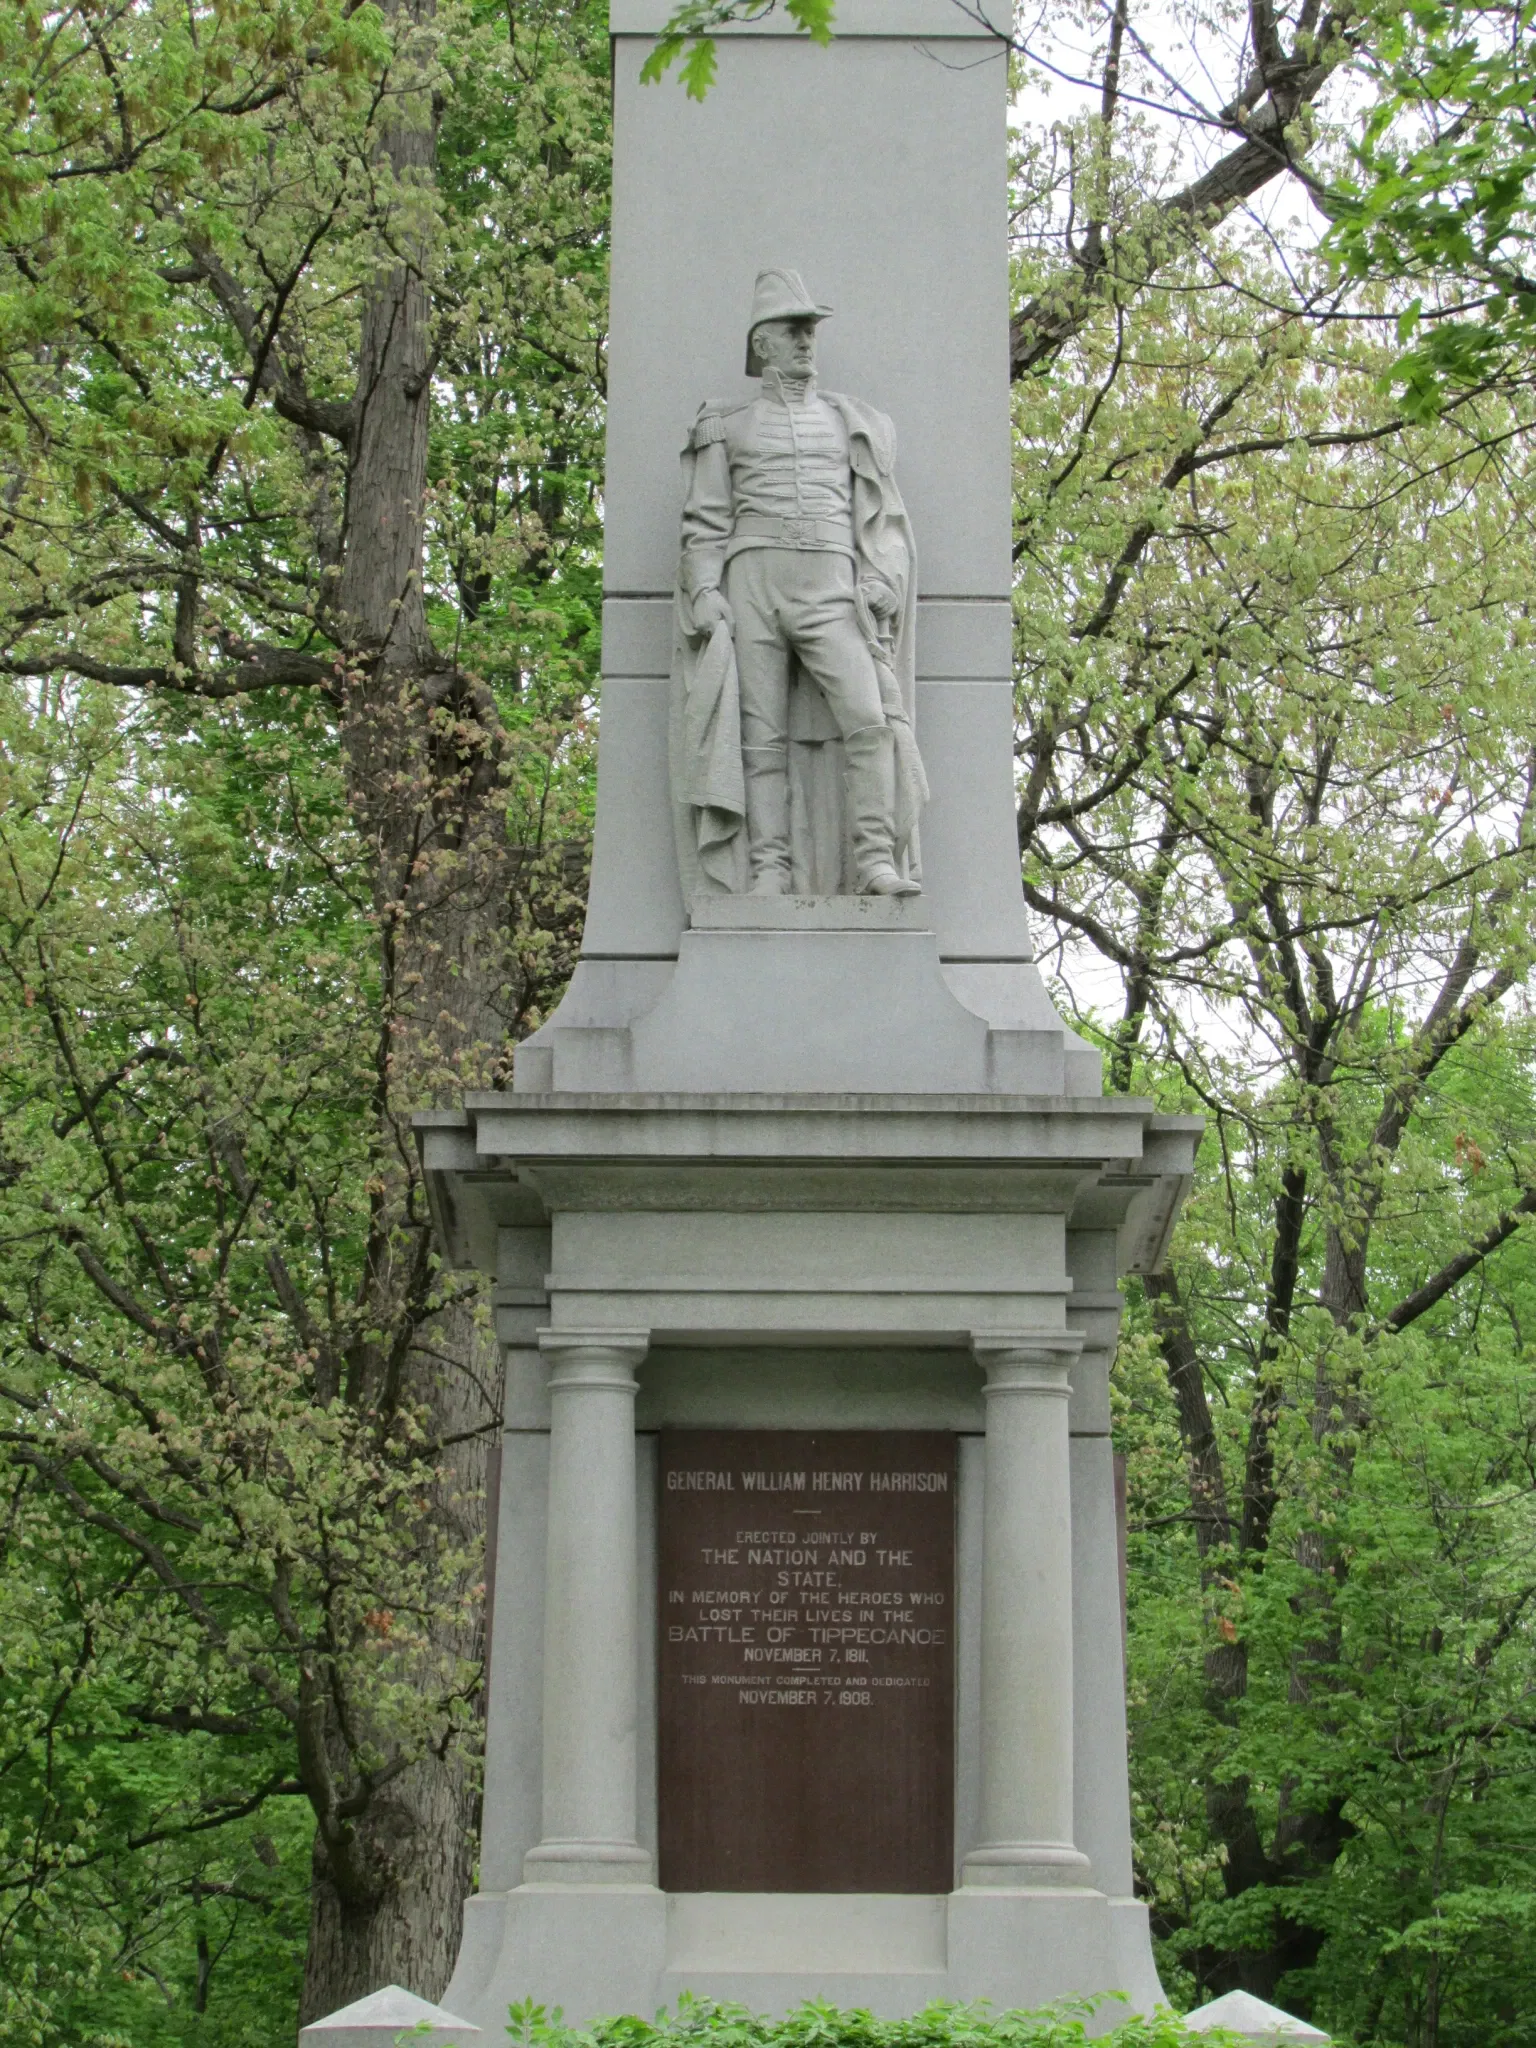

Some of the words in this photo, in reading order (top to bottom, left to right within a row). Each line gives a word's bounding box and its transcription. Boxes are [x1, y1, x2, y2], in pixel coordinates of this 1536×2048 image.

[666, 1471, 734, 1490] GENERAL
[742, 1471, 806, 1491] WILLIAM
[812, 1472, 864, 1491] HENRY
[870, 1472, 948, 1492] HARRISON
[736, 1531, 796, 1544] ERECTED
[802, 1532, 854, 1544] JOINTLY
[860, 1532, 878, 1545] BY
[701, 1548, 739, 1565] THE
[748, 1549, 818, 1566] NATION
[828, 1550, 866, 1566] AND
[876, 1550, 913, 1566] THE
[669, 1591, 684, 1604] IN
[692, 1590, 762, 1604] MEMORY
[770, 1592, 788, 1604] OF
[800, 1592, 830, 1604] THE
[838, 1592, 902, 1605] HEROES
[910, 1593, 944, 1606] WHO
[700, 1609, 743, 1621] LOST
[752, 1609, 798, 1622] THEIR
[806, 1610, 852, 1622] LIVES
[859, 1610, 874, 1622] IN
[883, 1610, 914, 1623] THE
[668, 1626, 755, 1642] BATTLE
[767, 1628, 796, 1643] OF
[808, 1628, 945, 1645] TIPPECANOE
[744, 1648, 822, 1662] NOVEMBER
[682, 1674, 706, 1684] THIS
[711, 1675, 772, 1685] MONUMENT
[776, 1676, 841, 1686] COMPLETED
[846, 1676, 867, 1686] AND
[872, 1677, 930, 1686] DEDICATED
[739, 1690, 817, 1705] NOVEMBER
